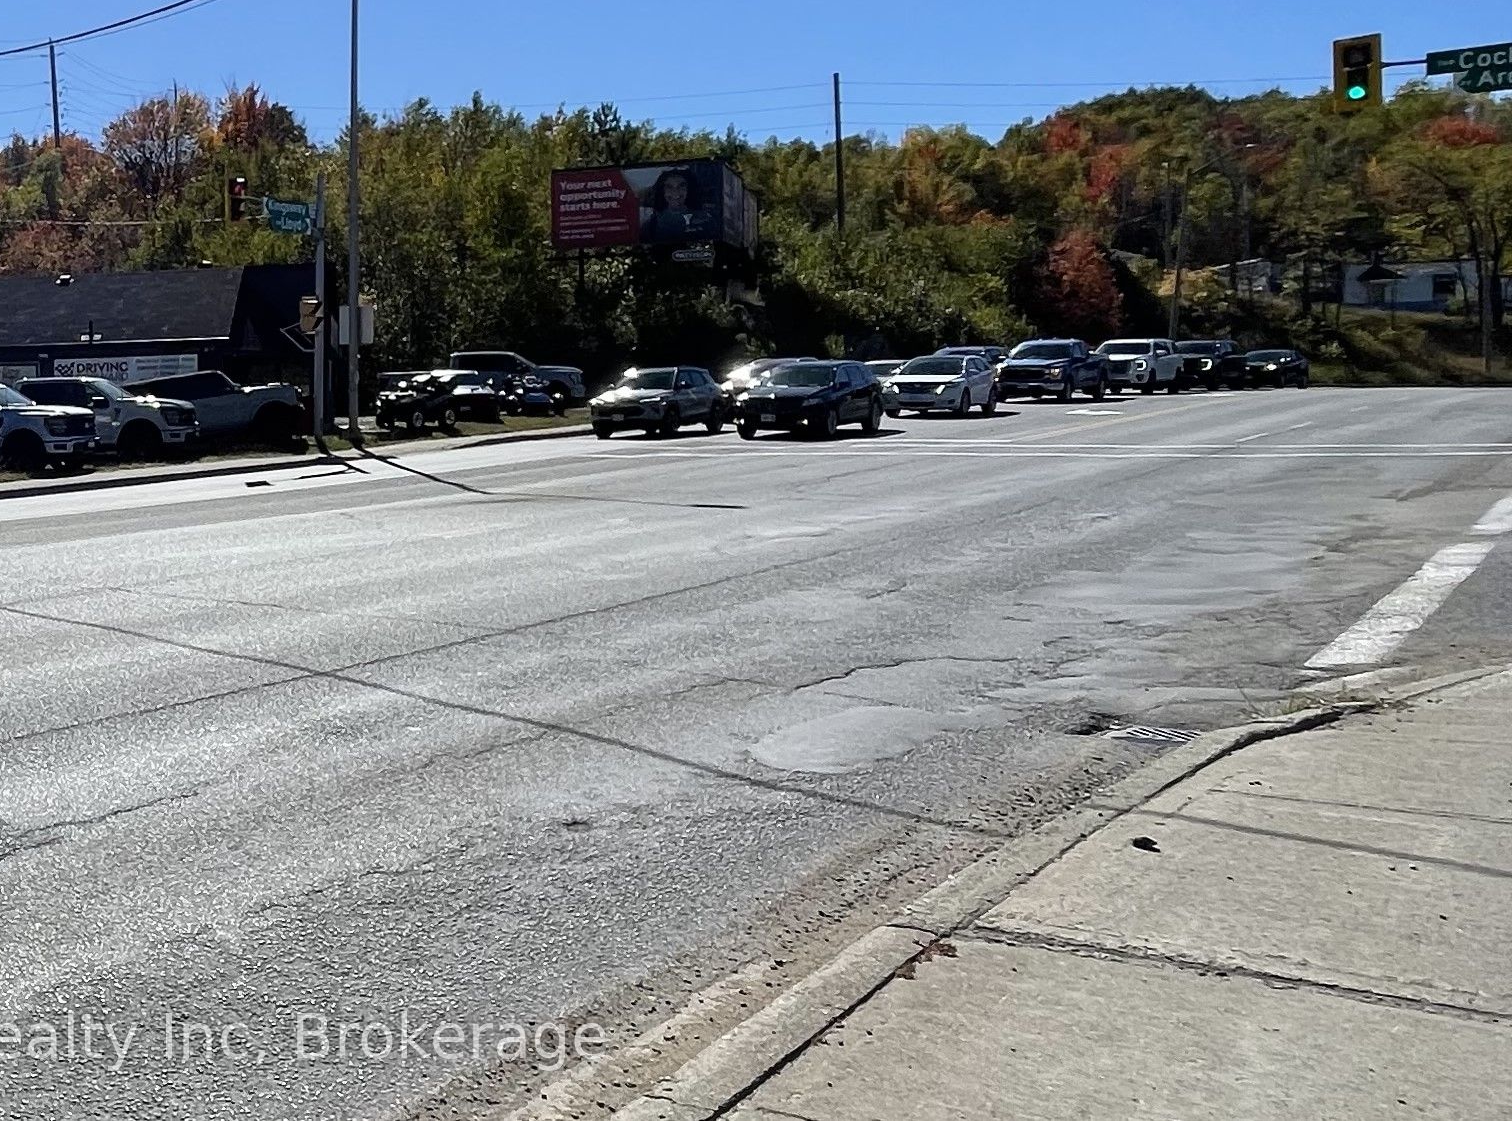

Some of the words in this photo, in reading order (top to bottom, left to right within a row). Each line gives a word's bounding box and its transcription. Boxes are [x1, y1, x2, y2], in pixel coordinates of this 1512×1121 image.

[1459, 46, 1512, 69] Coc
[1476, 69, 1512, 87] Ar
[560, 181, 585, 190] Your
[587, 179, 612, 188] next
[560, 188, 626, 202] opportunity
[560, 203, 590, 212] starts
[593, 201, 620, 209] here.
[76, 361, 129, 373] DRIVING
